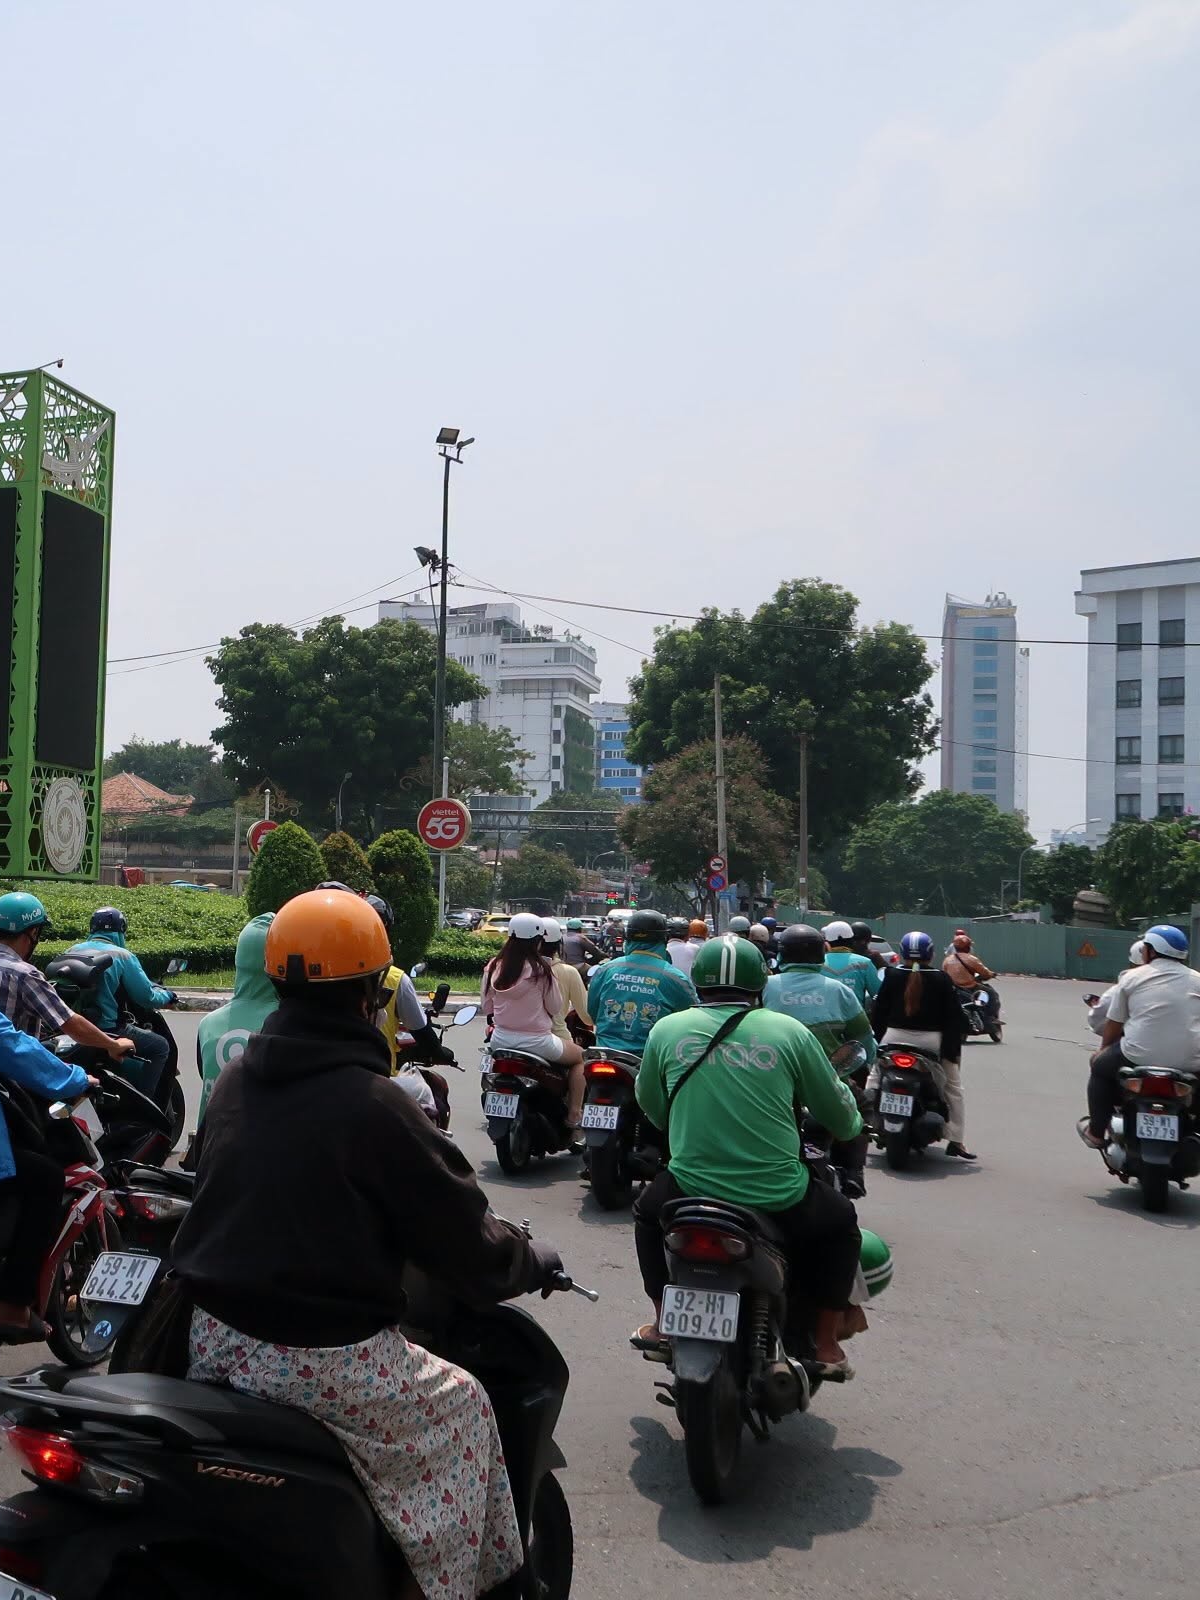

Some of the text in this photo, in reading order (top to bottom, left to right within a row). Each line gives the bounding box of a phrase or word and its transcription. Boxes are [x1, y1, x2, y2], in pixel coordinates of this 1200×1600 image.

[425, 817, 460, 840] 5G
[615, 983, 629, 991] Xin
[781, 991, 825, 1006] Grab
[676, 1033, 778, 1071] Grab
[86, 1276, 143, 1301] 844.24
[665, 1311, 733, 1338] 909.40
[197, 1462, 286, 1488] VISION
